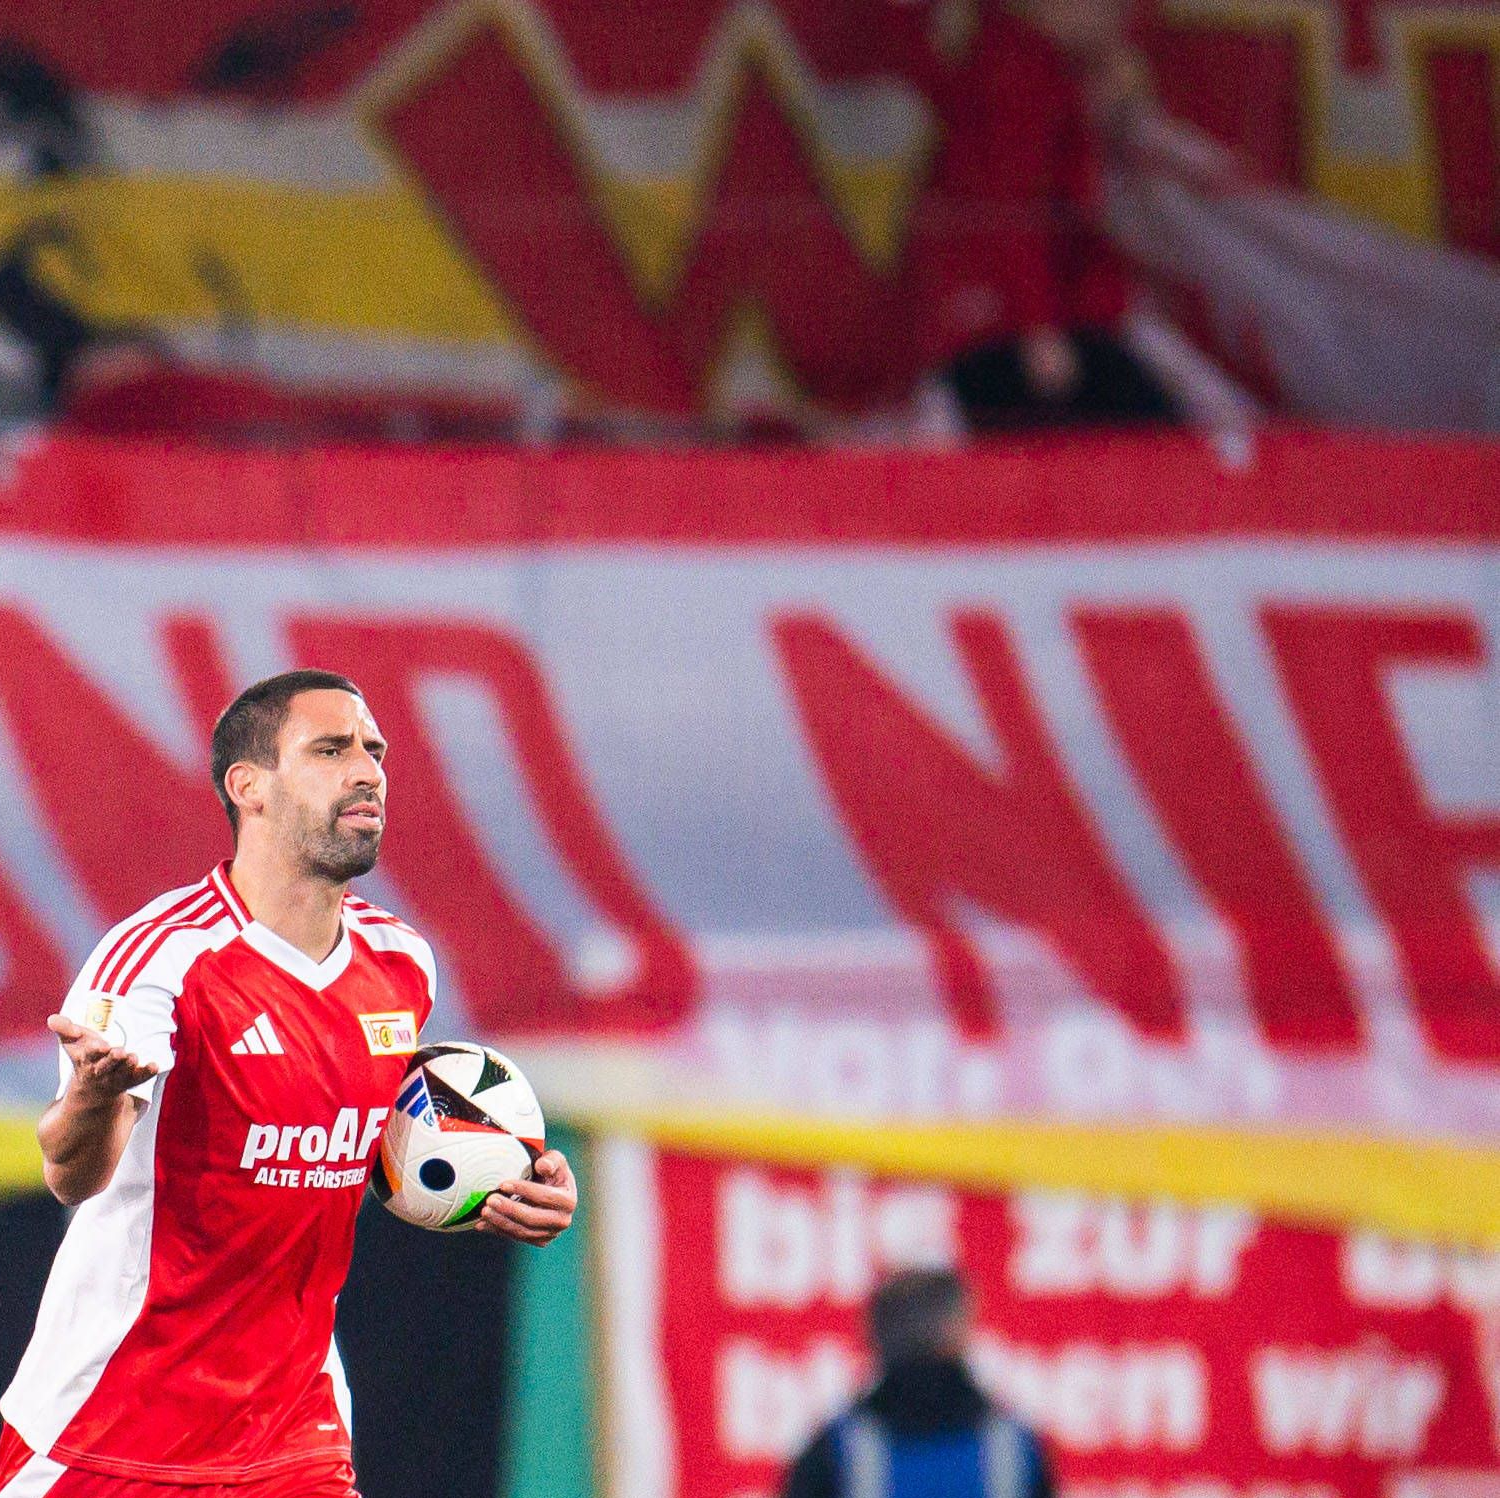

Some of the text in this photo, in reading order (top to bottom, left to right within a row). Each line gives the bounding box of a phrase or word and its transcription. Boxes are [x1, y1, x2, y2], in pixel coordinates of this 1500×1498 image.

[240, 1107, 389, 1169] proAF
[254, 1166, 301, 1188] ALTE
[1251, 1340, 1447, 1460] wir
